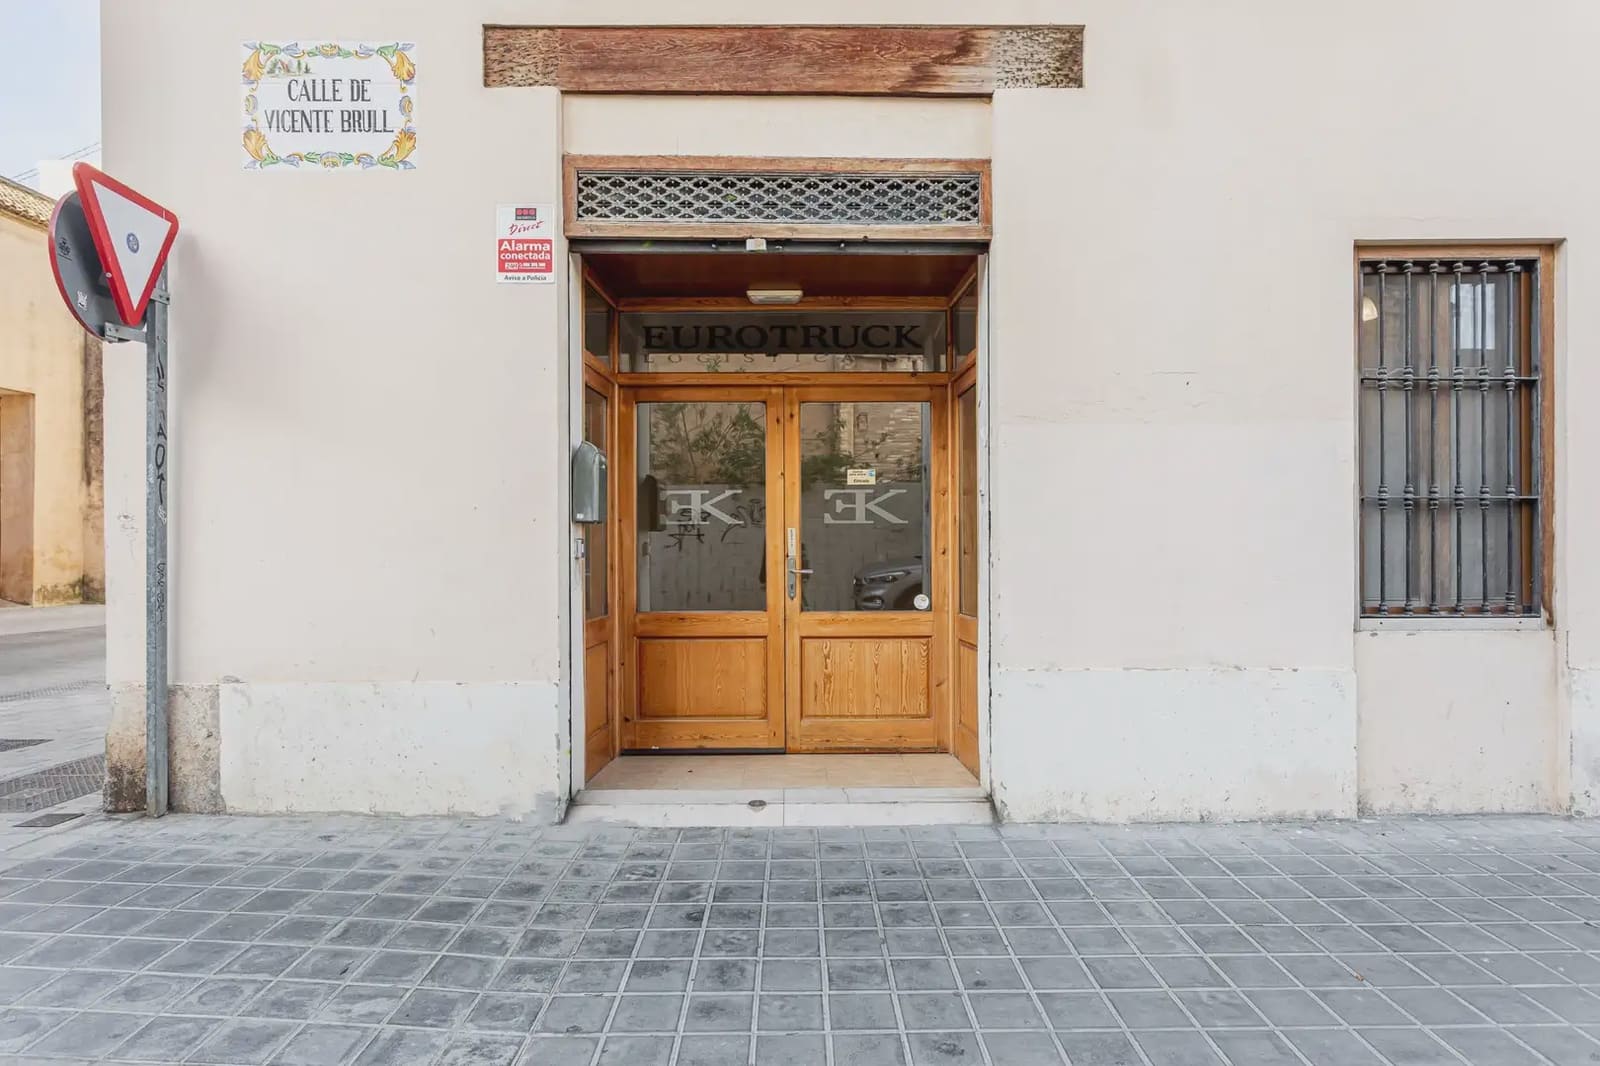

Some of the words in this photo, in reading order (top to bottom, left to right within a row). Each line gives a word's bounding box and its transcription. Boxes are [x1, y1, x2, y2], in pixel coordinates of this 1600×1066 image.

[287, 79, 343, 102] CALLE
[350, 79, 371, 102] DE
[264, 109, 334, 133] VICENTE
[341, 109, 395, 133] BRULL
[508, 220, 544, 235] Direct
[500, 240, 550, 251] Alarma
[500, 251, 551, 260] conectada
[642, 324, 923, 349] EUROTRUCK
